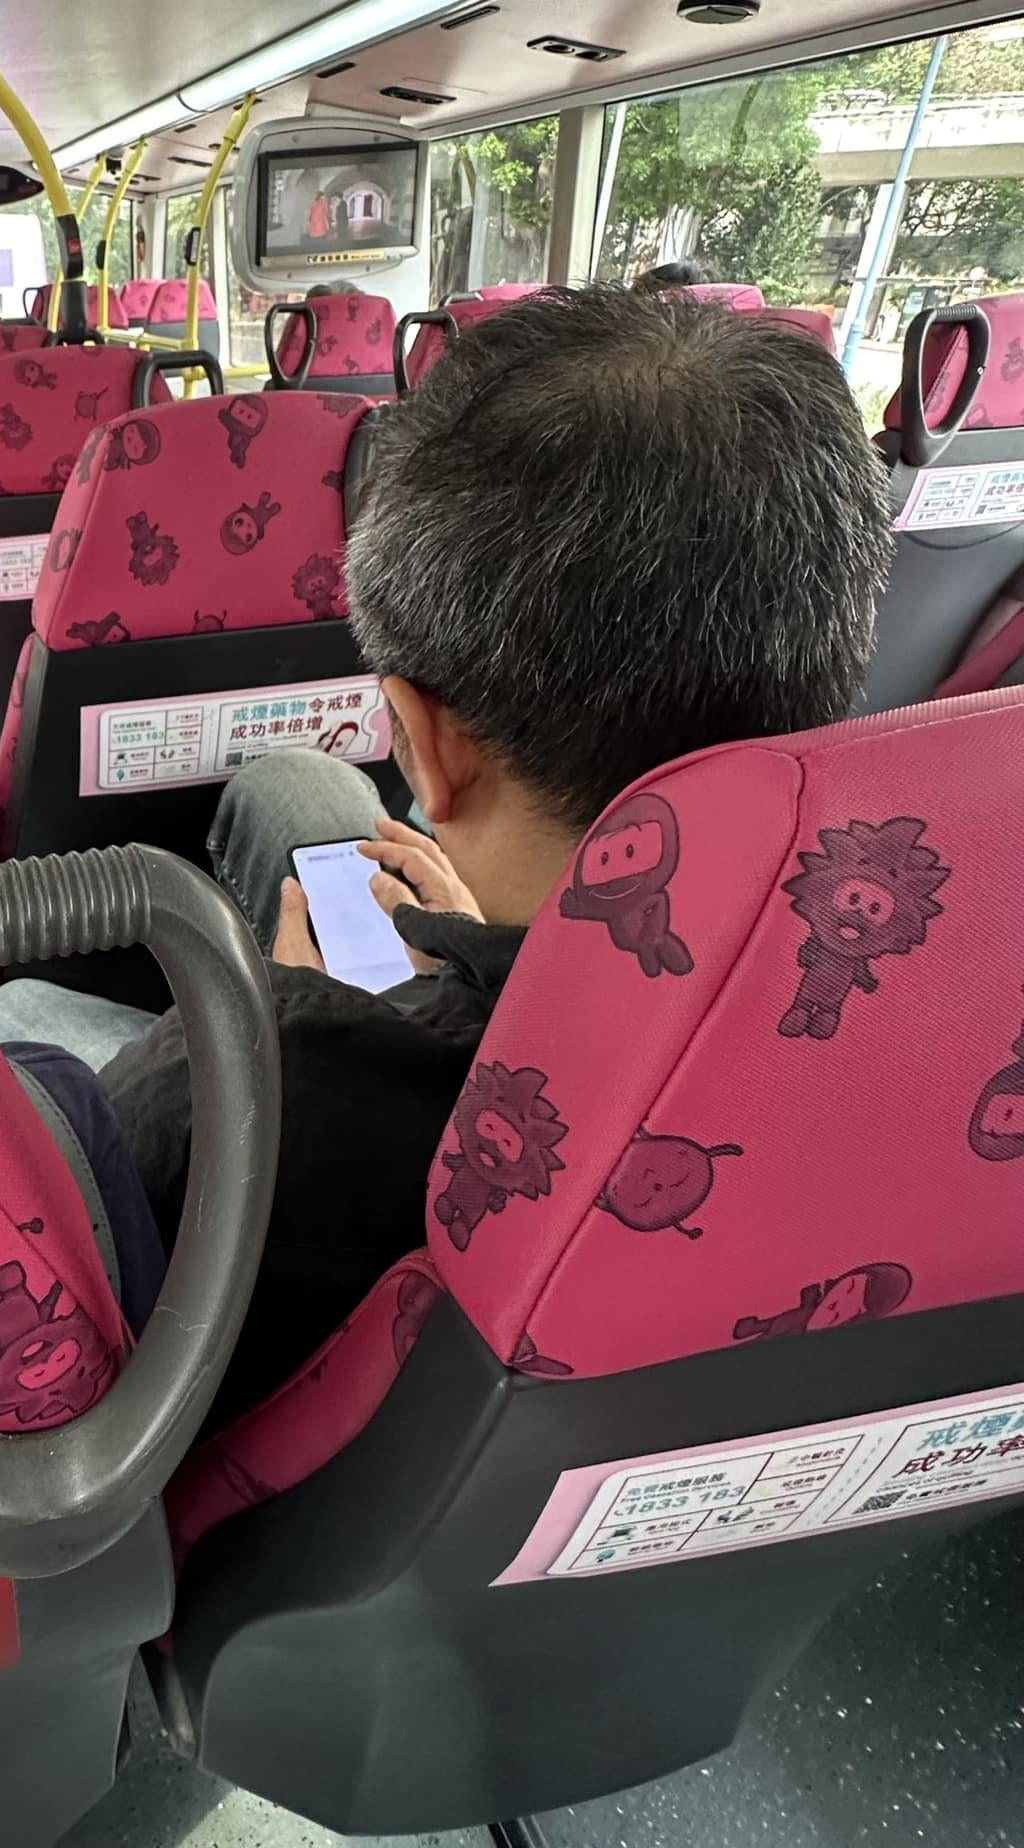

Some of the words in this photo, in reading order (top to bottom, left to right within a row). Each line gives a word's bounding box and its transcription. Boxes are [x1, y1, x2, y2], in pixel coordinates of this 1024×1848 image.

[229, 715, 324, 741] 成功率倍增
[917, 1409, 1024, 1450] 戒煙
[625, 1495, 689, 1515] 1833
[699, 1485, 746, 1503] 183
